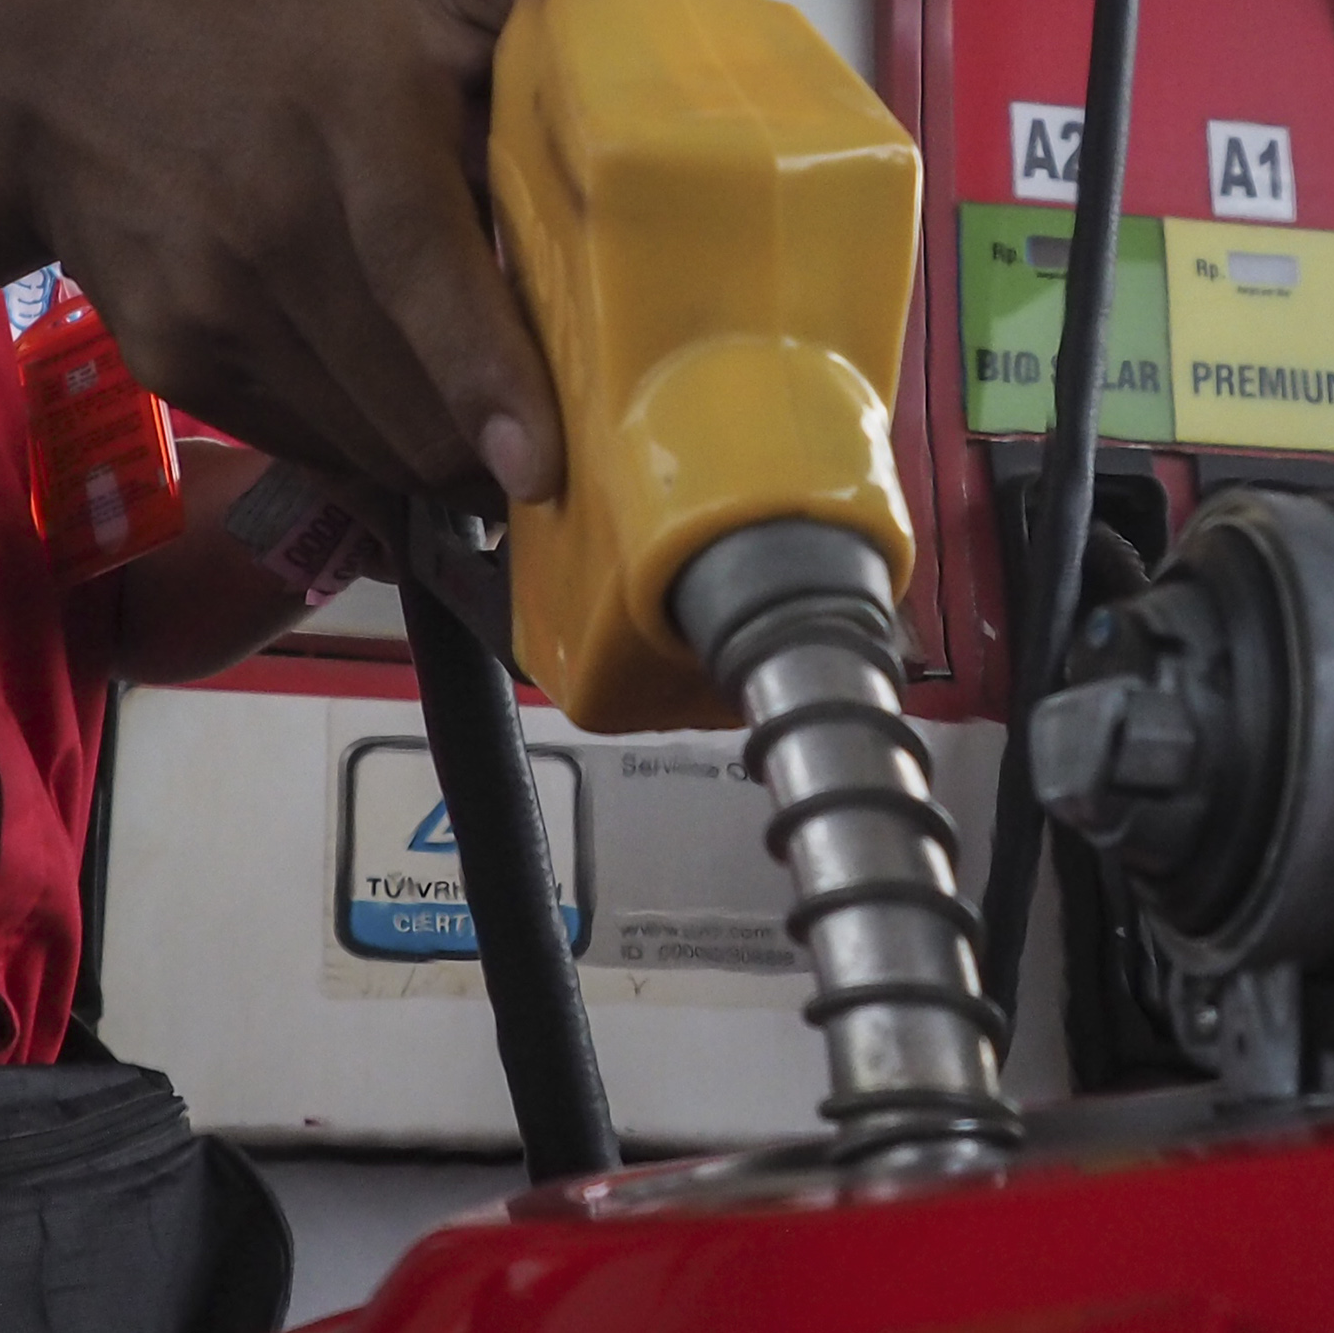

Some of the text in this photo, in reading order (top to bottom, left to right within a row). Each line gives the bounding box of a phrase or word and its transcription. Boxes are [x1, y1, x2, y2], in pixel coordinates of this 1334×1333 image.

[1023, 118, 1084, 182] A2
[1220, 136, 1283, 200] A1
[975, 348, 1161, 393] BIO LAR
